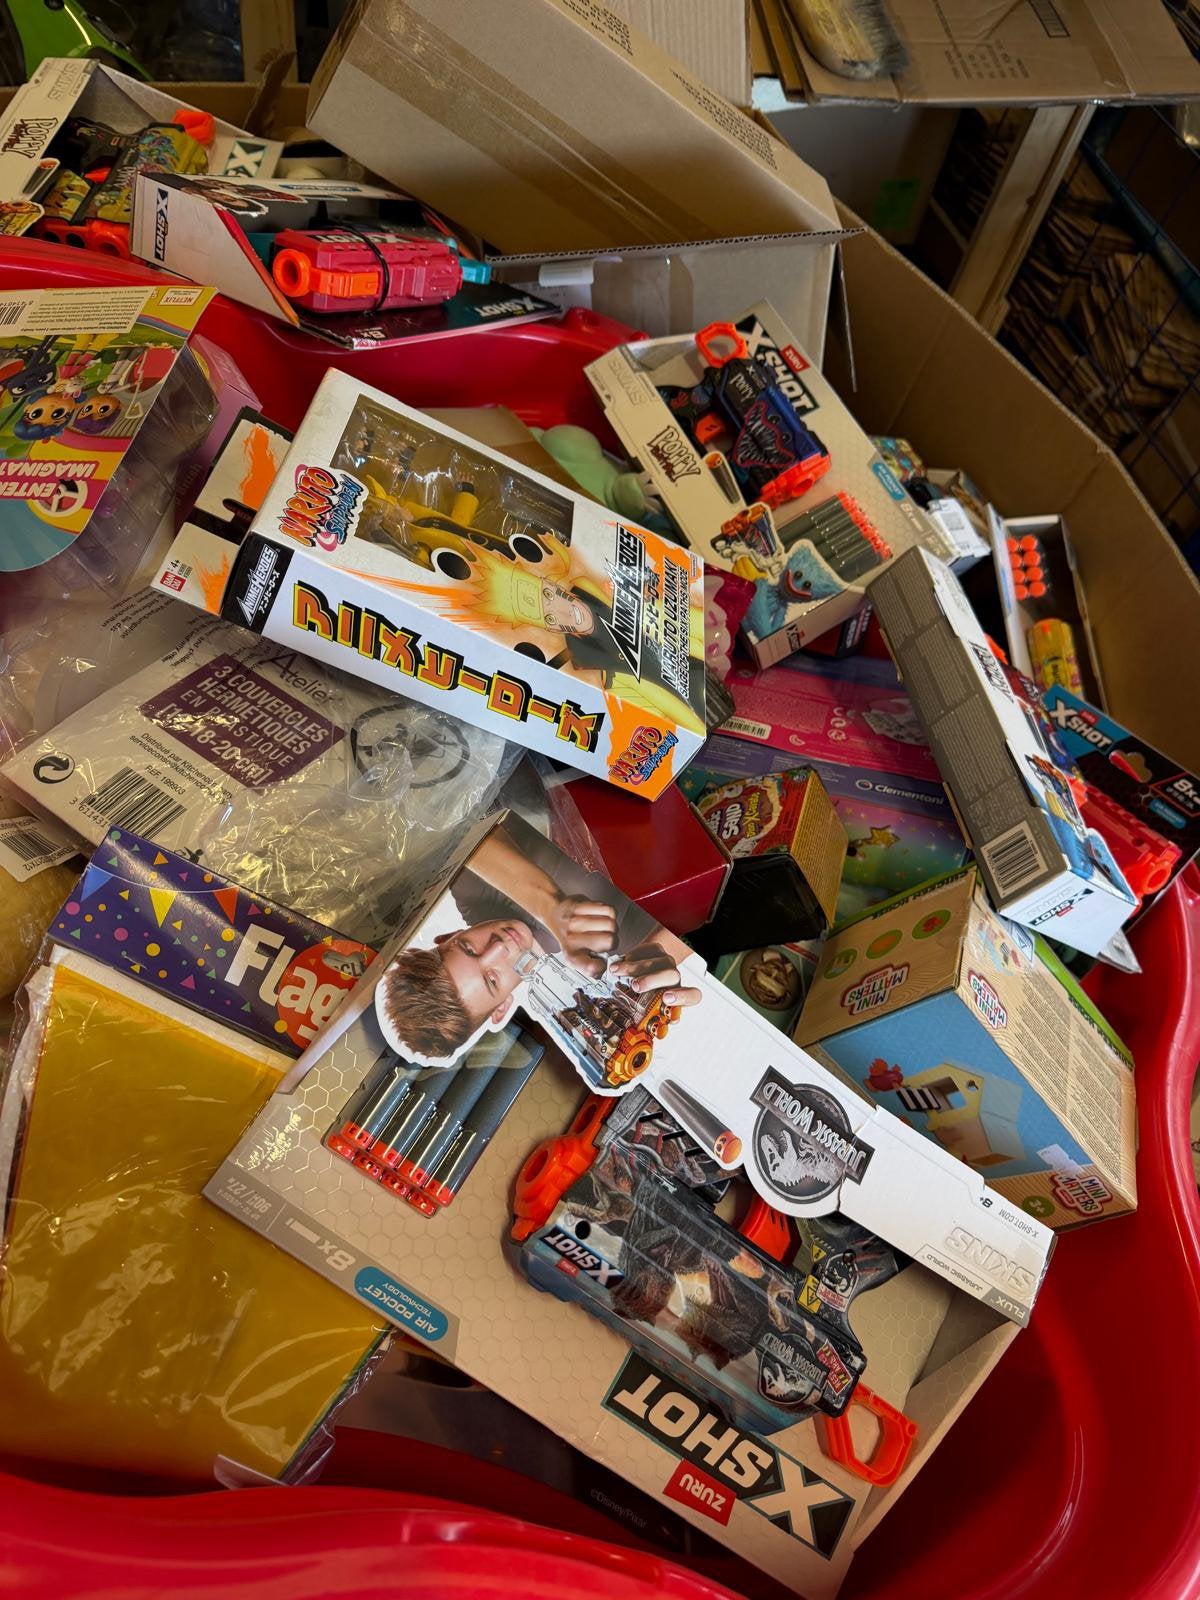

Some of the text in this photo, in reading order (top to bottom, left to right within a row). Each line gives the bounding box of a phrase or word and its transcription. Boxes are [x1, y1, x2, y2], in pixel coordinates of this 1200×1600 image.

[277, 466, 339, 547] NARUTO
[680, 568, 689, 590] MODE
[661, 556, 679, 690] NARUTO UZUMAKI
[679, 592, 689, 620] PATHS
[678, 620, 689, 637] SIX
[678, 637, 689, 656] THE
[259, 652, 337, 703] Atelier
[677, 671, 689, 699] SAGE
[180, 689, 208, 709] EN
[196, 676, 312, 756] HERMÉTIQUES
[214, 665, 330, 744] 3 COUVERCLES
[167, 750, 182, 767] par
[608, 727, 662, 783] NARUTO
[160, 775, 186, 796] 199903
[875, 783, 944, 806] Clementoni
[69, 797, 108, 829] 3 611431
[849, 968, 906, 1001] MATTERS
[855, 989, 887, 1013] MINI
[970, 976, 1006, 1025] MATTERS
[977, 994, 997, 1027] MINI
[762, 1081, 867, 1172] JURASSIC WORLD
[1058, 1172, 1100, 1213] MATTERS
[1082, 1177, 1108, 1199] MINI
[980, 1196, 1040, 1240] 8+ X-SHOT.COM
[1029, 1199, 1046, 1215] 3+
[926, 1253, 983, 1292] JURASSIC WORLD
[944, 1226, 1037, 1293] SKINS
[363, 1284, 439, 1336] AIR POCKET
[381, 1282, 433, 1318] TECHNOLOGY
[997, 1295, 1027, 1320] FLUX
[763, 1332, 828, 1383] JURASSIC WORLD
[678, 1472, 727, 1513] ZURU
